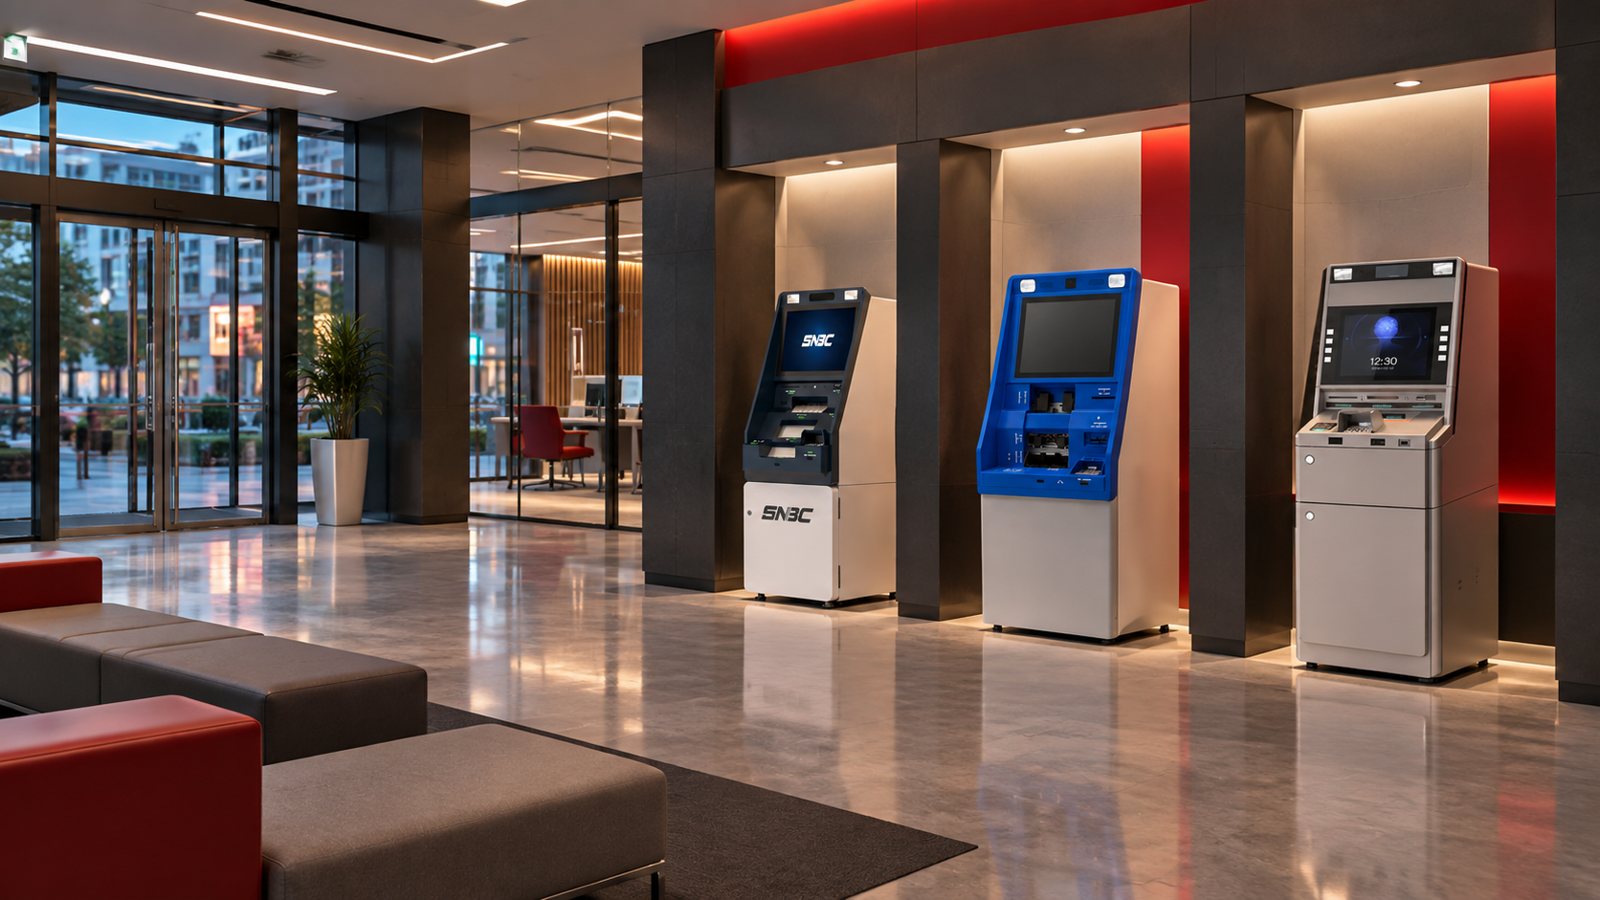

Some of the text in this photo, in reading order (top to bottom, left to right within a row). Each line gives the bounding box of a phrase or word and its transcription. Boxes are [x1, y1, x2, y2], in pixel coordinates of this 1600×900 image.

[801, 333, 835, 347] SNBC
[1370, 356, 1398, 366] 12:30
[761, 505, 814, 523] SNBC
